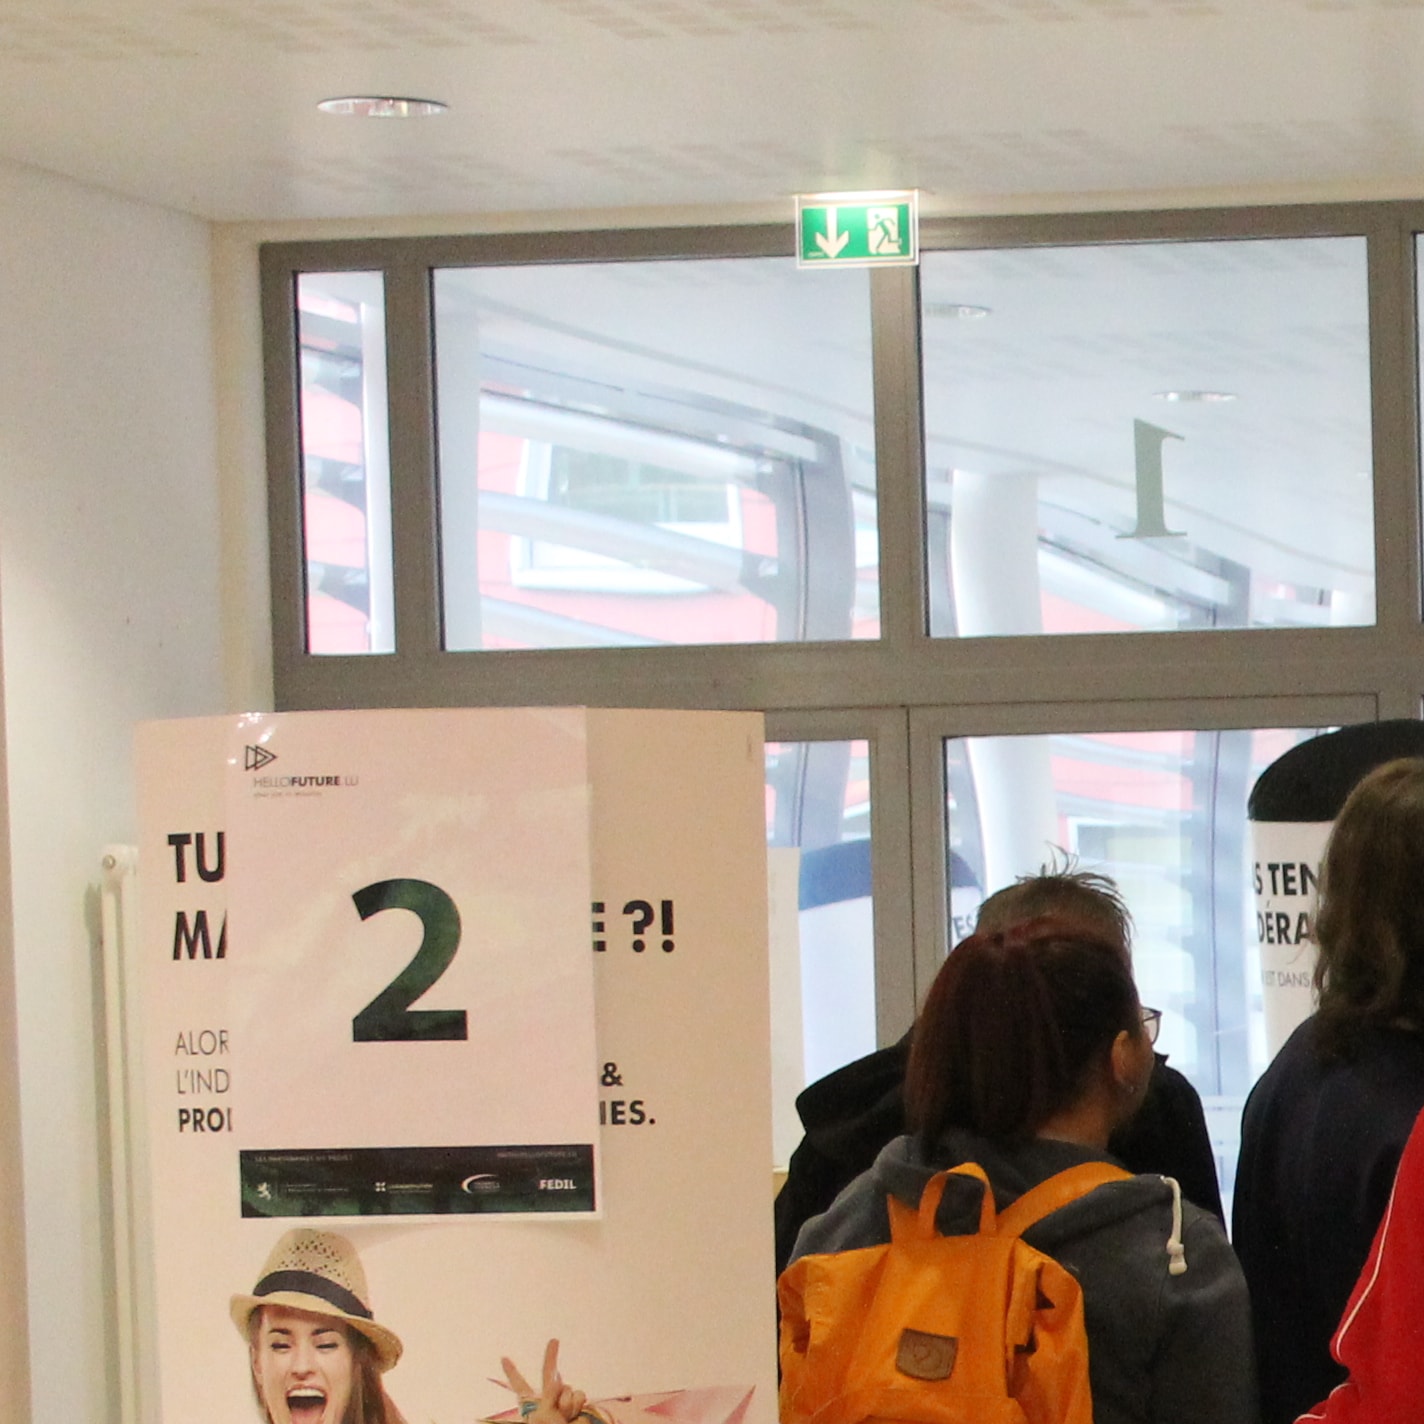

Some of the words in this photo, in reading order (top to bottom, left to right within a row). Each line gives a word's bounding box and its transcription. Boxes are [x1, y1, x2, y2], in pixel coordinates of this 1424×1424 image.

[167, 831, 225, 883] TU
[351, 877, 469, 1042] 2
[601, 1062, 623, 1086] &
[538, 1178, 577, 1190] FEDIL
